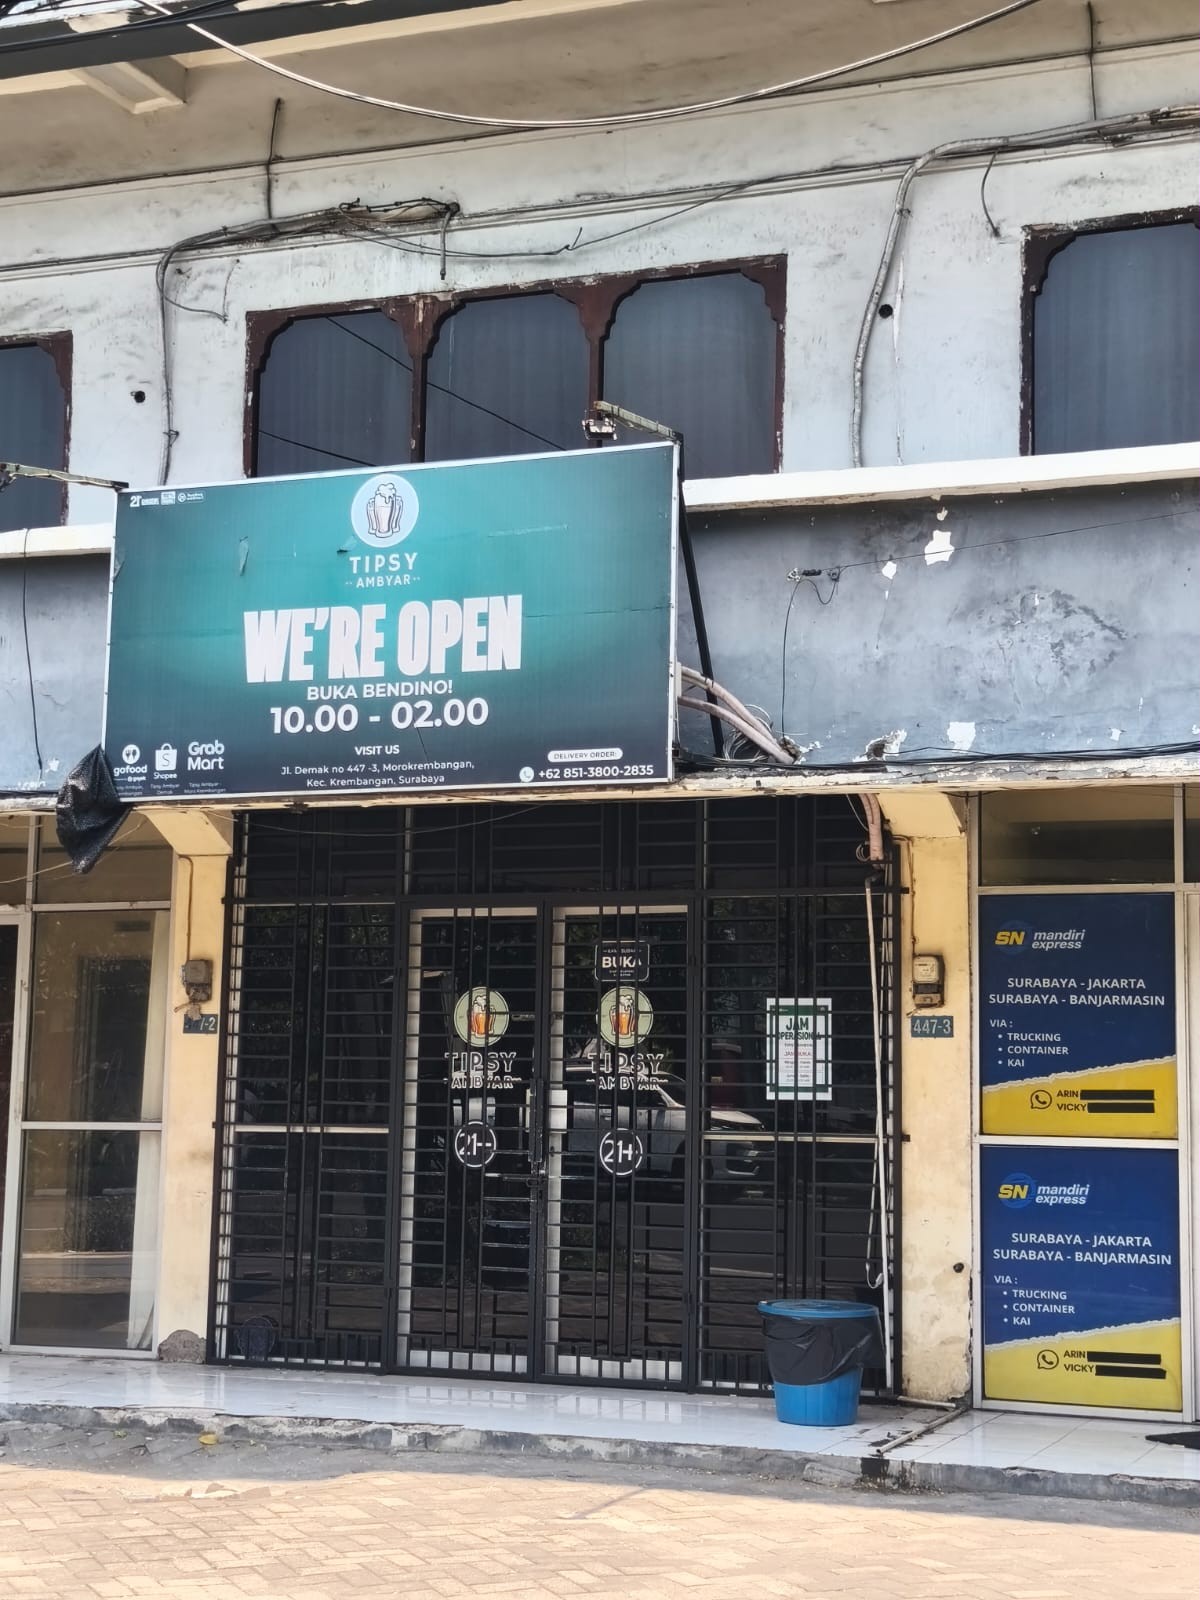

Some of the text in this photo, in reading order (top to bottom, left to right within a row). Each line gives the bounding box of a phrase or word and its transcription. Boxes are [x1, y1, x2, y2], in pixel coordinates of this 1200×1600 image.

[350, 553, 418, 573] TIPSY
[356, 575, 411, 588] AMBYAR
[244, 594, 522, 683] WE'RE OPEN
[307, 680, 453, 700] BUKA BENDINO!
[270, 704, 359, 734] 10.00
[391, 698, 489, 729] 02.00
[188, 739, 225, 756] Grab
[355, 745, 400, 756] VISIT US
[554, 750, 618, 760] DELIVERY ORDER:
[187, 756, 224, 771] Mart
[281, 766, 291, 775] Jl.
[295, 765, 329, 775] Demak
[332, 766, 343, 774] no
[347, 764, 365, 774] 447
[383, 760, 475, 774] Morokrembangan,
[113, 764, 148, 777] gofood
[153, 772, 178, 781] Shopee
[538, 765, 654, 779] +62 851-3800-2835
[307, 778, 327, 787] Kec.
[399, 774, 445, 786] Surabaya
[995, 929, 1086, 945] SN mandiri
[1031, 940, 1082, 951] express
[1007, 978, 1077, 988] SURABAYA
[1087, 978, 1146, 990] JAKARTA
[989, 994, 1058, 1004] SURABAYA
[1069, 995, 1165, 1007] BANJARMASIN
[786, 1017, 809, 1030] JM
[913, 1019, 951, 1035] 447-3
[990, 1019, 1008, 1028] VIA
[1007, 1033, 1061, 1042] TRUCKING
[1007, 1046, 1069, 1055] CONTAINER
[444, 1052, 517, 1073] TIPSY
[587, 1053, 664, 1074] TIPSY
[1007, 1059, 1025, 1067] KAI
[1057, 1090, 1079, 1098] ARIN
[1057, 1103, 1087, 1112] VICKY
[998, 1184, 1090, 1199] SN mandiri
[1035, 1195, 1087, 1206] express
[1011, 1233, 1082, 1245] SURABAYA
[1092, 1235, 1152, 1248] JAKARTA
[993, 1249, 1063, 1261] SURABAYA
[1075, 1252, 1172, 1265] BANJARMASIN
[994, 1275, 1012, 1284] VIA
[1012, 1290, 1067, 1300] TRUCKING
[1012, 1303, 1075, 1314] CONTAINER
[1013, 1317, 1031, 1325] KAI
[1063, 1350, 1086, 1359] ARIN
[1063, 1364, 1095, 1373] VICKY
